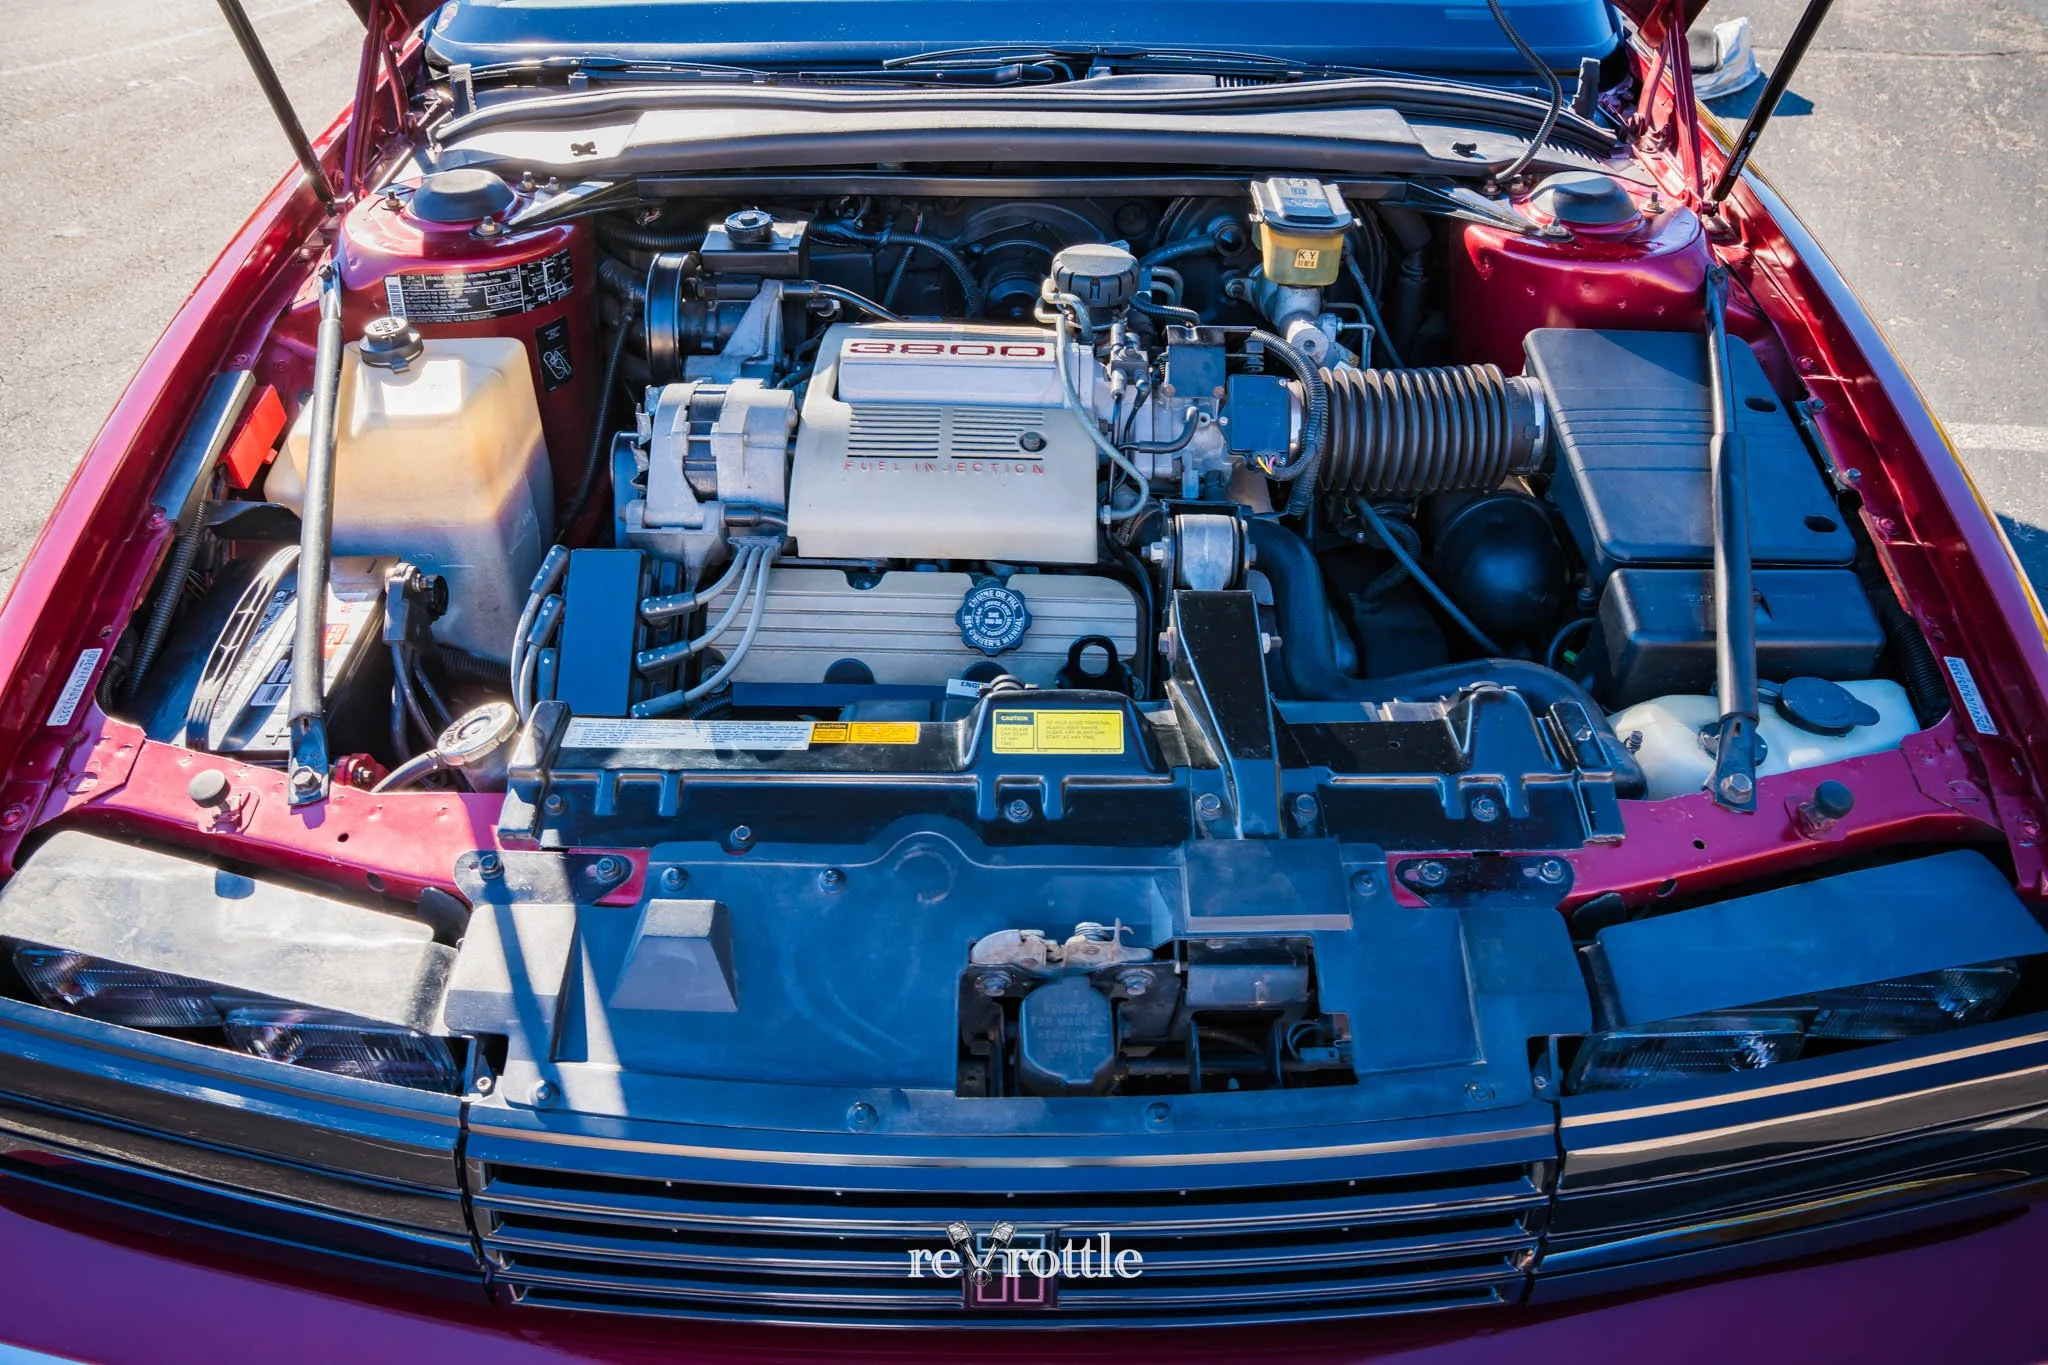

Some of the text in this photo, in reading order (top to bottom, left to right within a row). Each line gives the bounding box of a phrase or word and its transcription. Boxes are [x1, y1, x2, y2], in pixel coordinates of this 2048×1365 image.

[487, 281, 520, 293] CATALYST
[849, 342, 1046, 357] 3800
[843, 461, 1046, 475] FUEL INJECTION
[968, 590, 994, 608] ENGINE
[995, 590, 1006, 600] OIL
[1006, 596, 1020, 610] FILL
[964, 615, 974, 629] SEE
[968, 629, 1002, 647] OWNER'S
[1001, 617, 1024, 645] MANUAL
